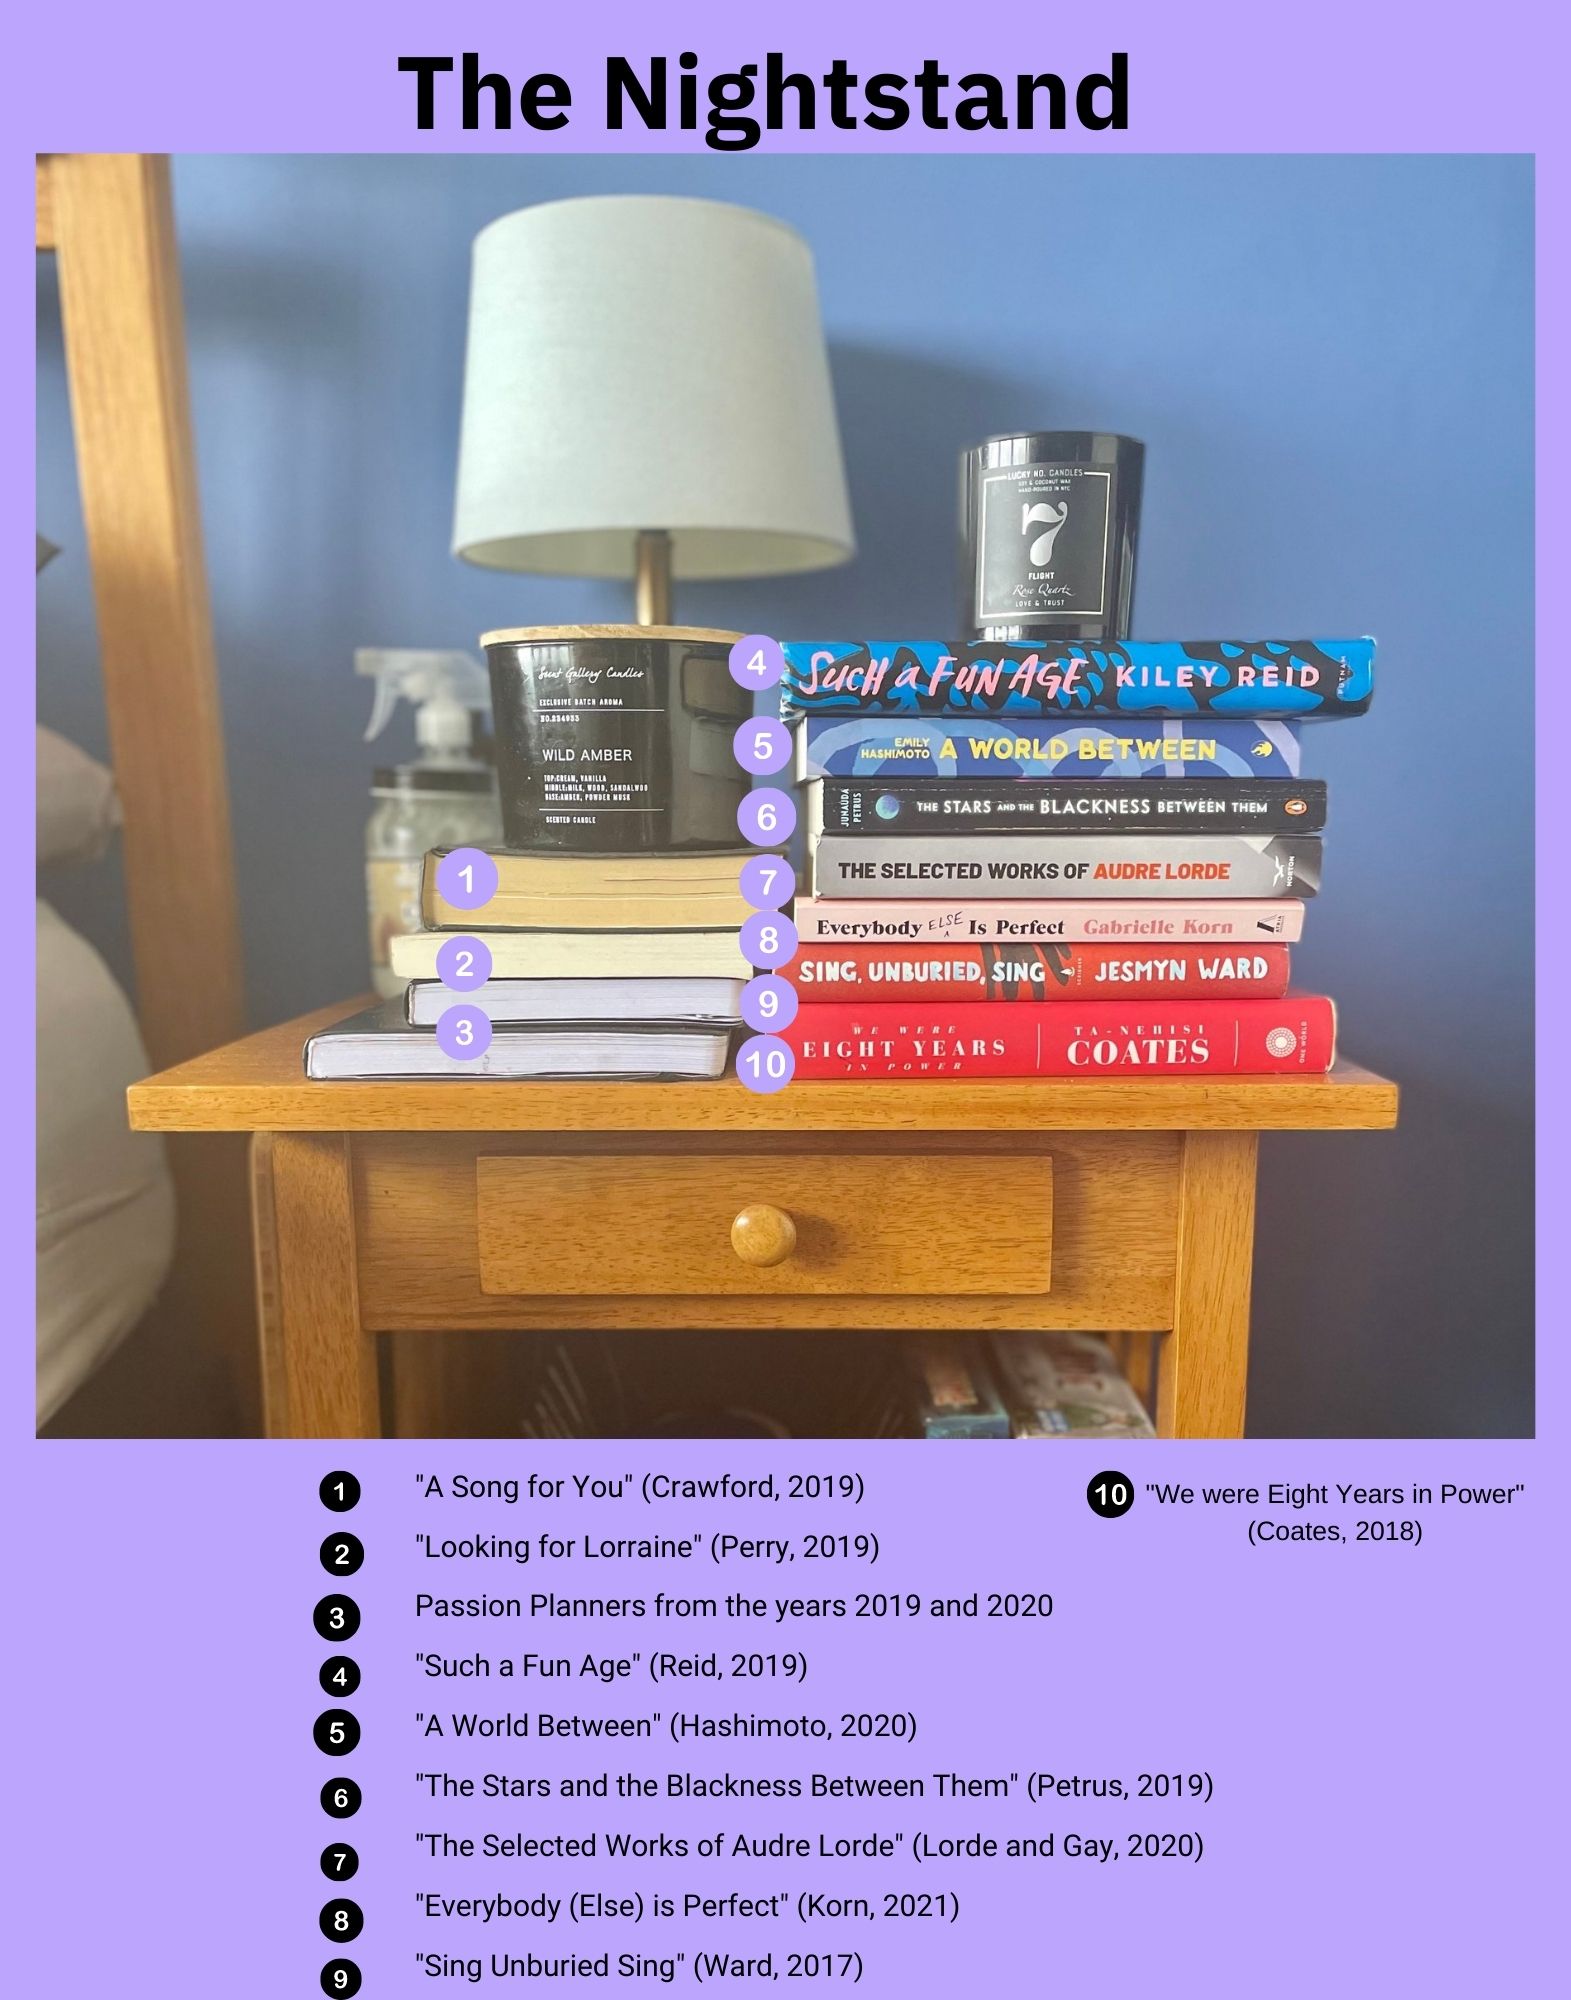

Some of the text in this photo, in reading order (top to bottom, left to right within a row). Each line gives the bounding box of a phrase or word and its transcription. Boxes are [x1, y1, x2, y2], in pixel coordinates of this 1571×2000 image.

[1008, 468, 1082, 480] LUCKY NO. CANDLES
[1022, 501, 1068, 567] 7
[1028, 572, 1055, 580] FLIGHT
[1012, 583, 1076, 597] Rose Quartz
[565, 666, 645, 684] Gallery Candles
[800, 651, 1320, 699] SUCH a FUN AGE KILEY REID
[1338, 655, 1347, 696] PUTNAM
[539, 698, 623, 706] EXCLUSIVE BATCH AROMA
[894, 737, 930, 748] EMILY
[939, 738, 1216, 760] A WORLD BETWEEN
[542, 749, 633, 761] WILD AMBER
[860, 748, 931, 759] HASHIMOTO
[585, 793, 631, 801] POWDER MUSK
[841, 788, 850, 827] JUNAUDA
[852, 792, 862, 823] PETRUS
[917, 799, 1268, 814] THE STARS AND THE BLACKNESS BETWEEN THEM
[838, 862, 1231, 880] THE SELECTED WORKS OF AUDRE LORDE
[1286, 856, 1295, 887] NORTON
[817, 911, 1233, 938] Everybody ELSE Is Perfect Gabrielle Korn
[799, 961, 1046, 985] SING, UNBURIED, SING
[1094, 956, 1268, 982] JESMYN WARD
[853, 1025, 956, 1035] WE WERE
[1074, 1024, 1205, 1036] TA-NEHISI
[1300, 1021, 1308, 1046] WORLD
[803, 1039, 1006, 1058] EIGHT YEARS
[1067, 1038, 1209, 1066] COATES
[845, 1062, 963, 1072] IN POWER
